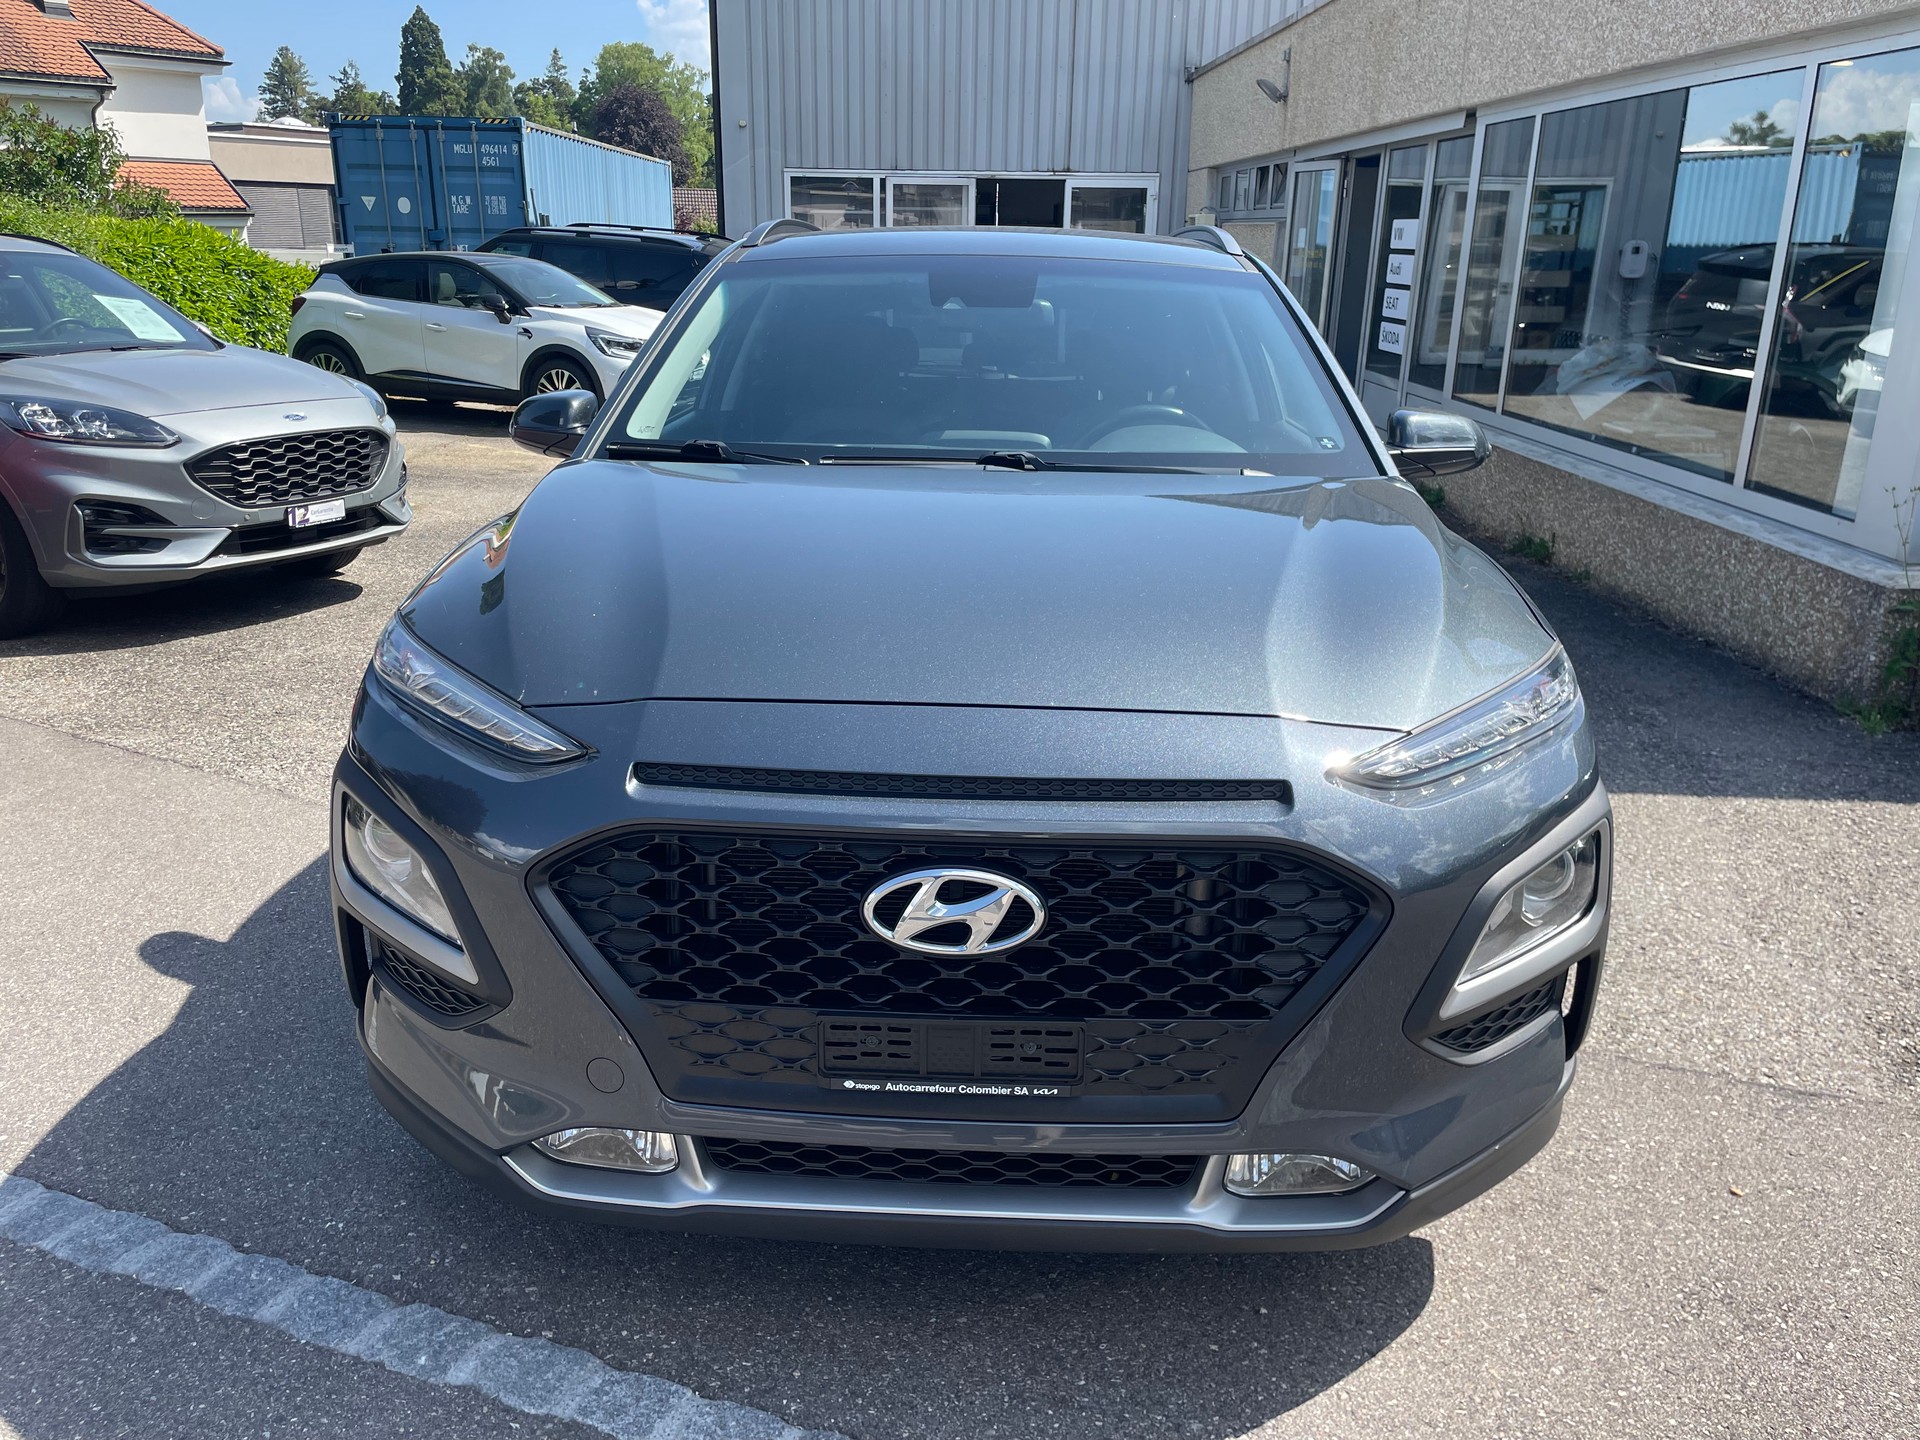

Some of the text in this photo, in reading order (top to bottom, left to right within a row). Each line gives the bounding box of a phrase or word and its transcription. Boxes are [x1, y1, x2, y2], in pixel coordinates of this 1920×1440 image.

[453, 143, 519, 155] MGLU 496414 9
[482, 156, 500, 167] 45G1
[452, 204, 469, 214] TARE
[1394, 227, 1404, 241] VW
[1389, 262, 1402, 276] Audi
[1385, 296, 1399, 310] SEAT
[885, 1082, 957, 1093] Autocarrefour
[958, 1084, 1012, 1095] Colombier
[1013, 1086, 1029, 1096] SA
